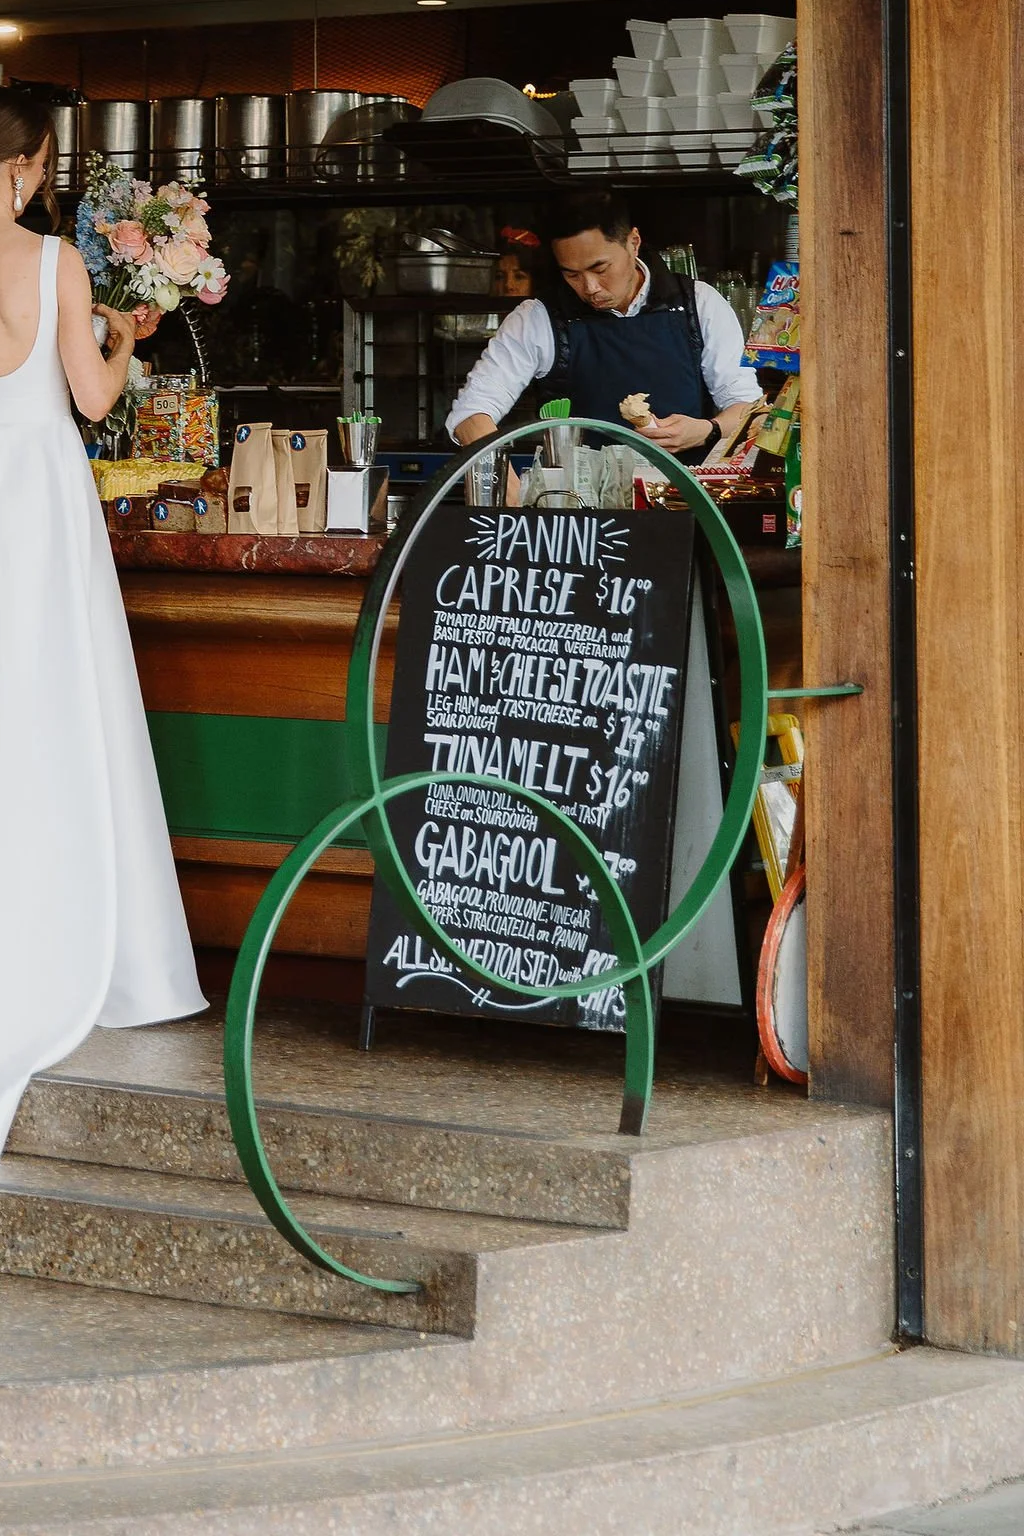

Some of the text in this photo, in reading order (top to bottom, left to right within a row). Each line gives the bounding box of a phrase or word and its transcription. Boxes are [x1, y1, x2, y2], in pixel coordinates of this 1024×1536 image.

[495, 514, 598, 566] PANINI
[435, 564, 584, 615] CAPRESE
[477, 613, 531, 635] BUFFALO
[532, 618, 607, 644] MOZZERELLA
[611, 627, 634, 644] and
[497, 635, 512, 648] on
[511, 634, 559, 655] FOCACCIA
[425, 644, 485, 695] HAM
[499, 652, 584, 705] CHEESE
[581, 658, 678, 716] TOASTIE
[426, 711, 498, 733] SOURDOUGH
[427, 693, 453, 714] LEG
[453, 695, 478, 715] HAM
[479, 699, 502, 716] and
[535, 703, 583, 727] CHEESE
[583, 715, 599, 729] on
[424, 733, 503, 780] TUNA
[503, 737, 590, 796] MELT
[425, 797, 460, 820] CHEESE
[460, 807, 475, 821] on
[474, 805, 539, 833] SOURDOUGH
[577, 803, 611, 830] TASTY
[414, 820, 566, 896] GABAGOOL
[462, 908, 536, 941] STRACCIATELLA
[536, 929, 551, 942] on
[551, 925, 589, 952] PANINI
[549, 901, 591, 929] VINEGAR
[382, 935, 429, 970] ALL
[494, 942, 560, 988] TOASTED
[558, 966, 582, 983] with
